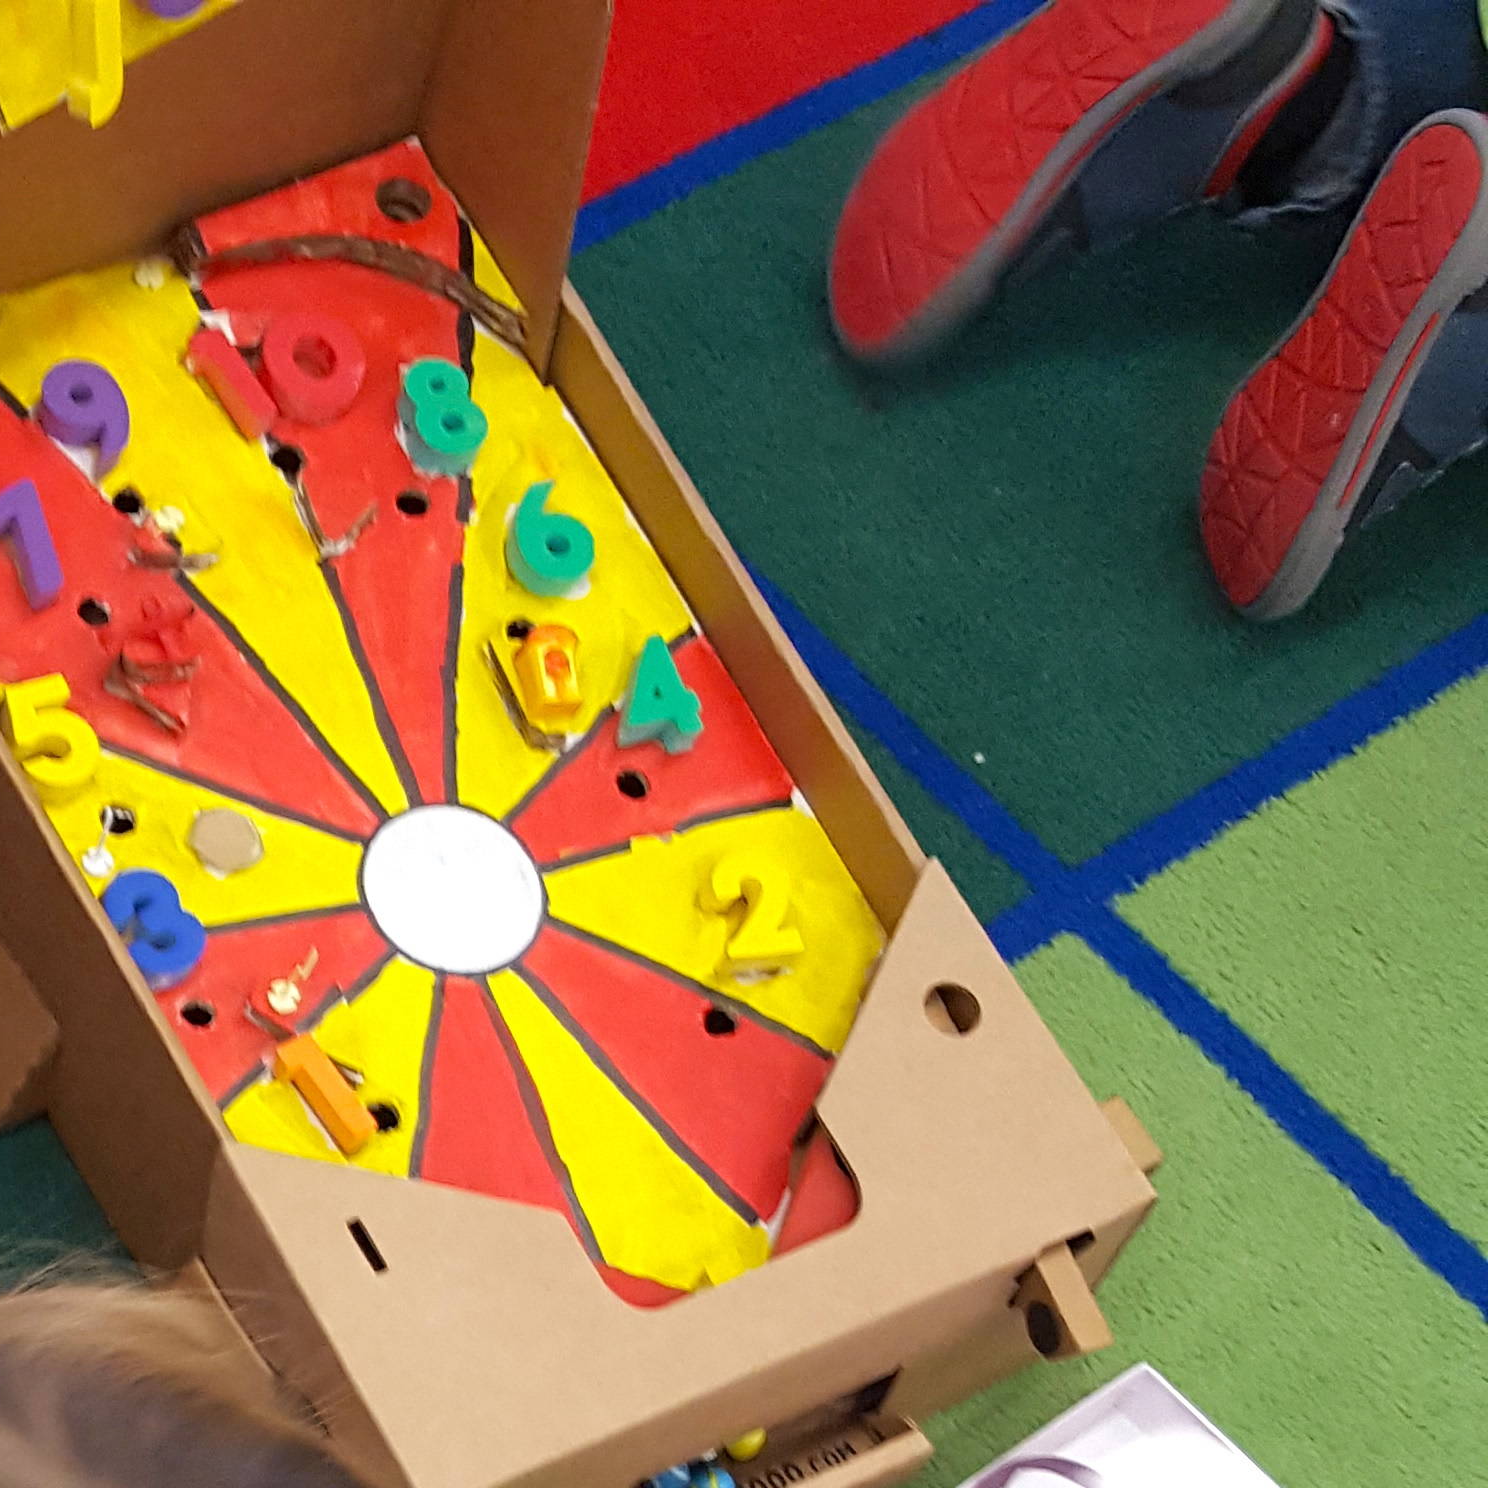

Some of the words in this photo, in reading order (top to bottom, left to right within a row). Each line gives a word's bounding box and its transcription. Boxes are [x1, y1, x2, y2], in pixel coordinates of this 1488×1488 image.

[38, 358, 130, 484] 9
[400, 357, 490, 474] 8
[506, 480, 595, 597] 6
[2, 671, 102, 787] 5
[618, 634, 704, 754] 4
[101, 866, 208, 991] 3
[702, 847, 806, 966] 2
[272, 1031, 379, 1156] 1
